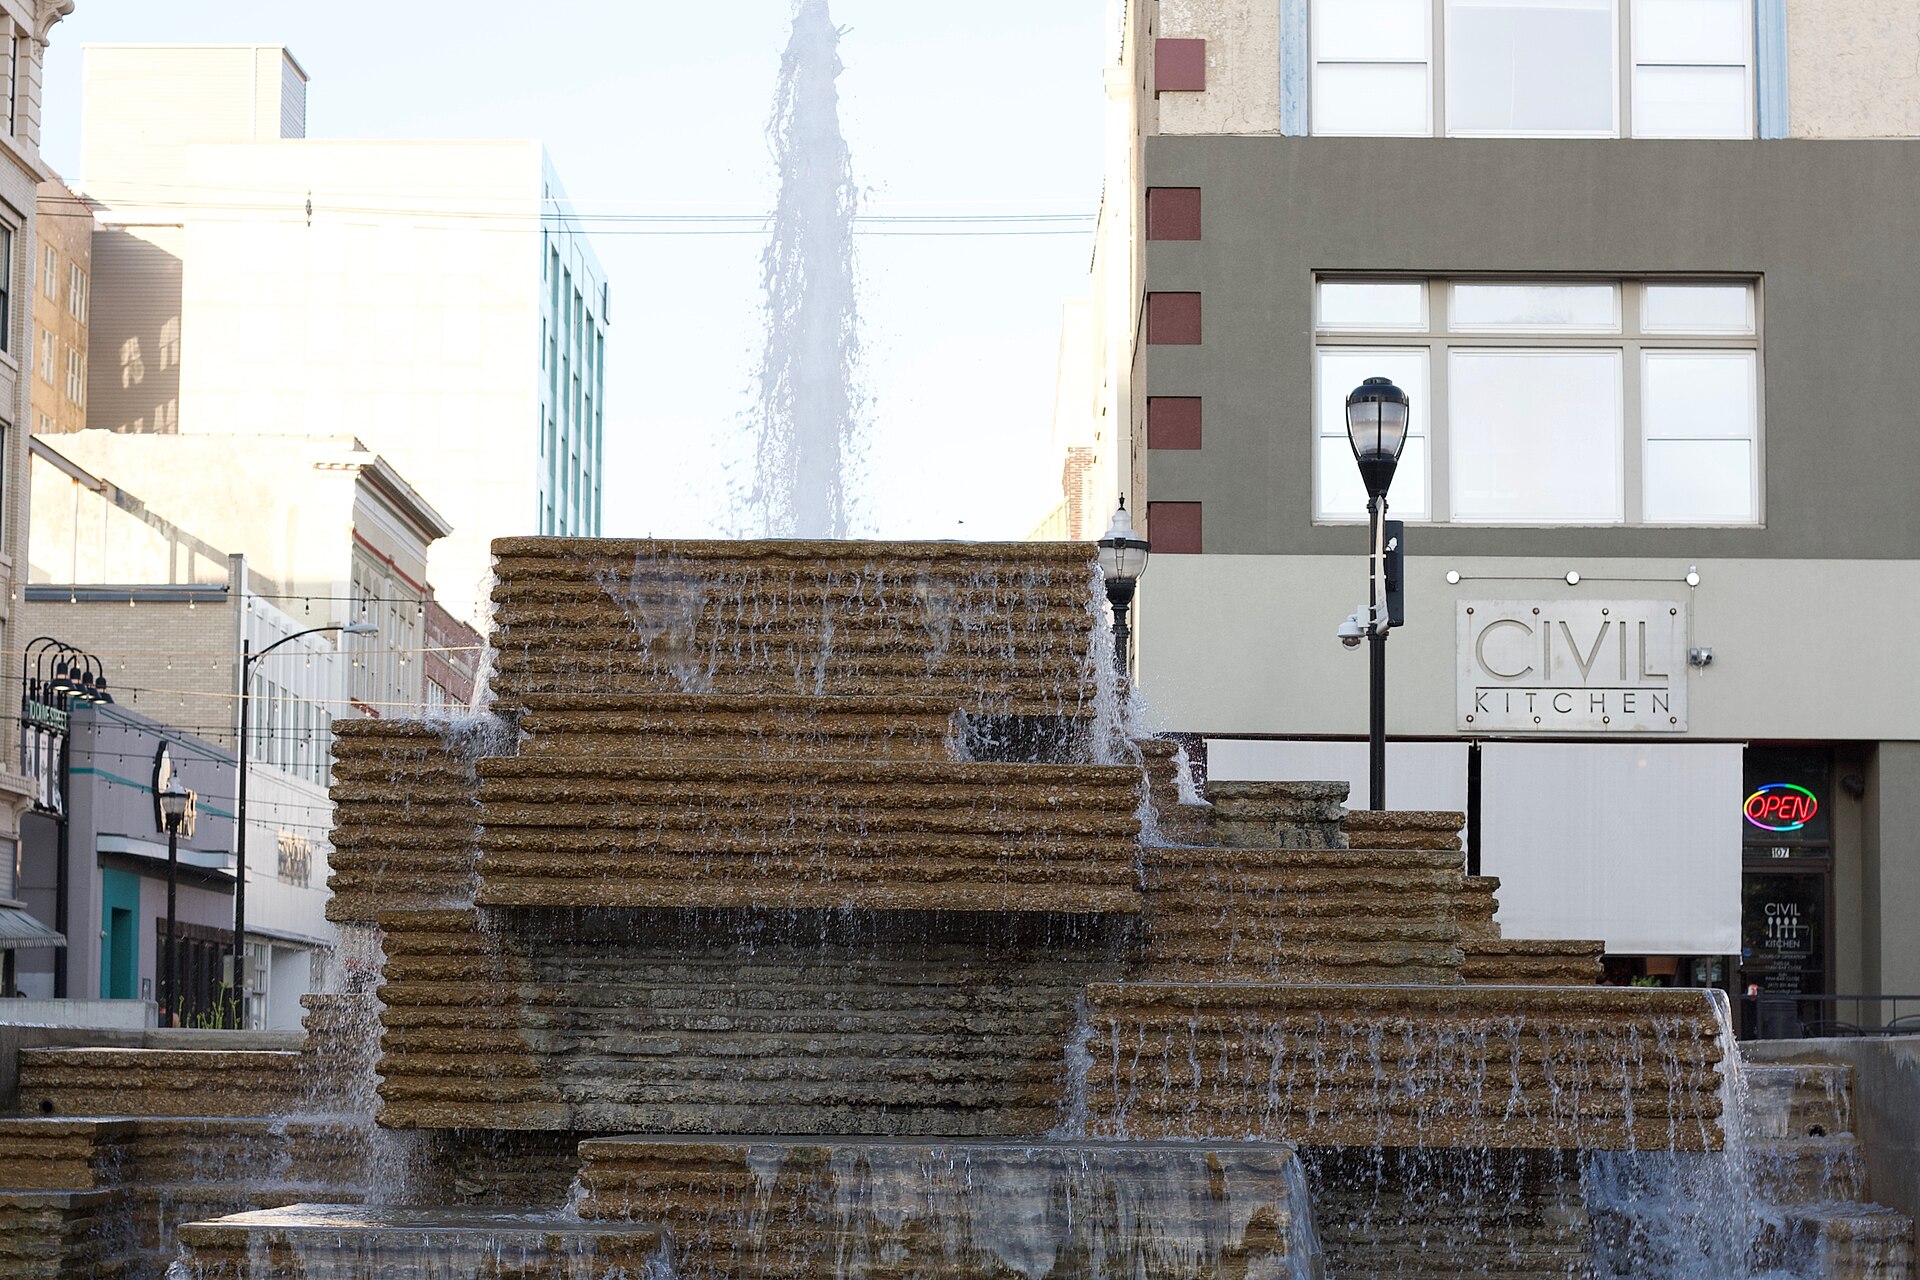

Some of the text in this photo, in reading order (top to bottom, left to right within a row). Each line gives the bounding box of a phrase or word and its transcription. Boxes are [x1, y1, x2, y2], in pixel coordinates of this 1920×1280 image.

[1475, 618, 1669, 682] CIVIL
[1475, 692, 1669, 714] KITCHEN
[1748, 795, 1810, 819] OPEN
[1772, 848, 1789, 858] 107
[1764, 902, 1800, 916] CIVIL
[1765, 940, 1800, 949] KITCHEN
